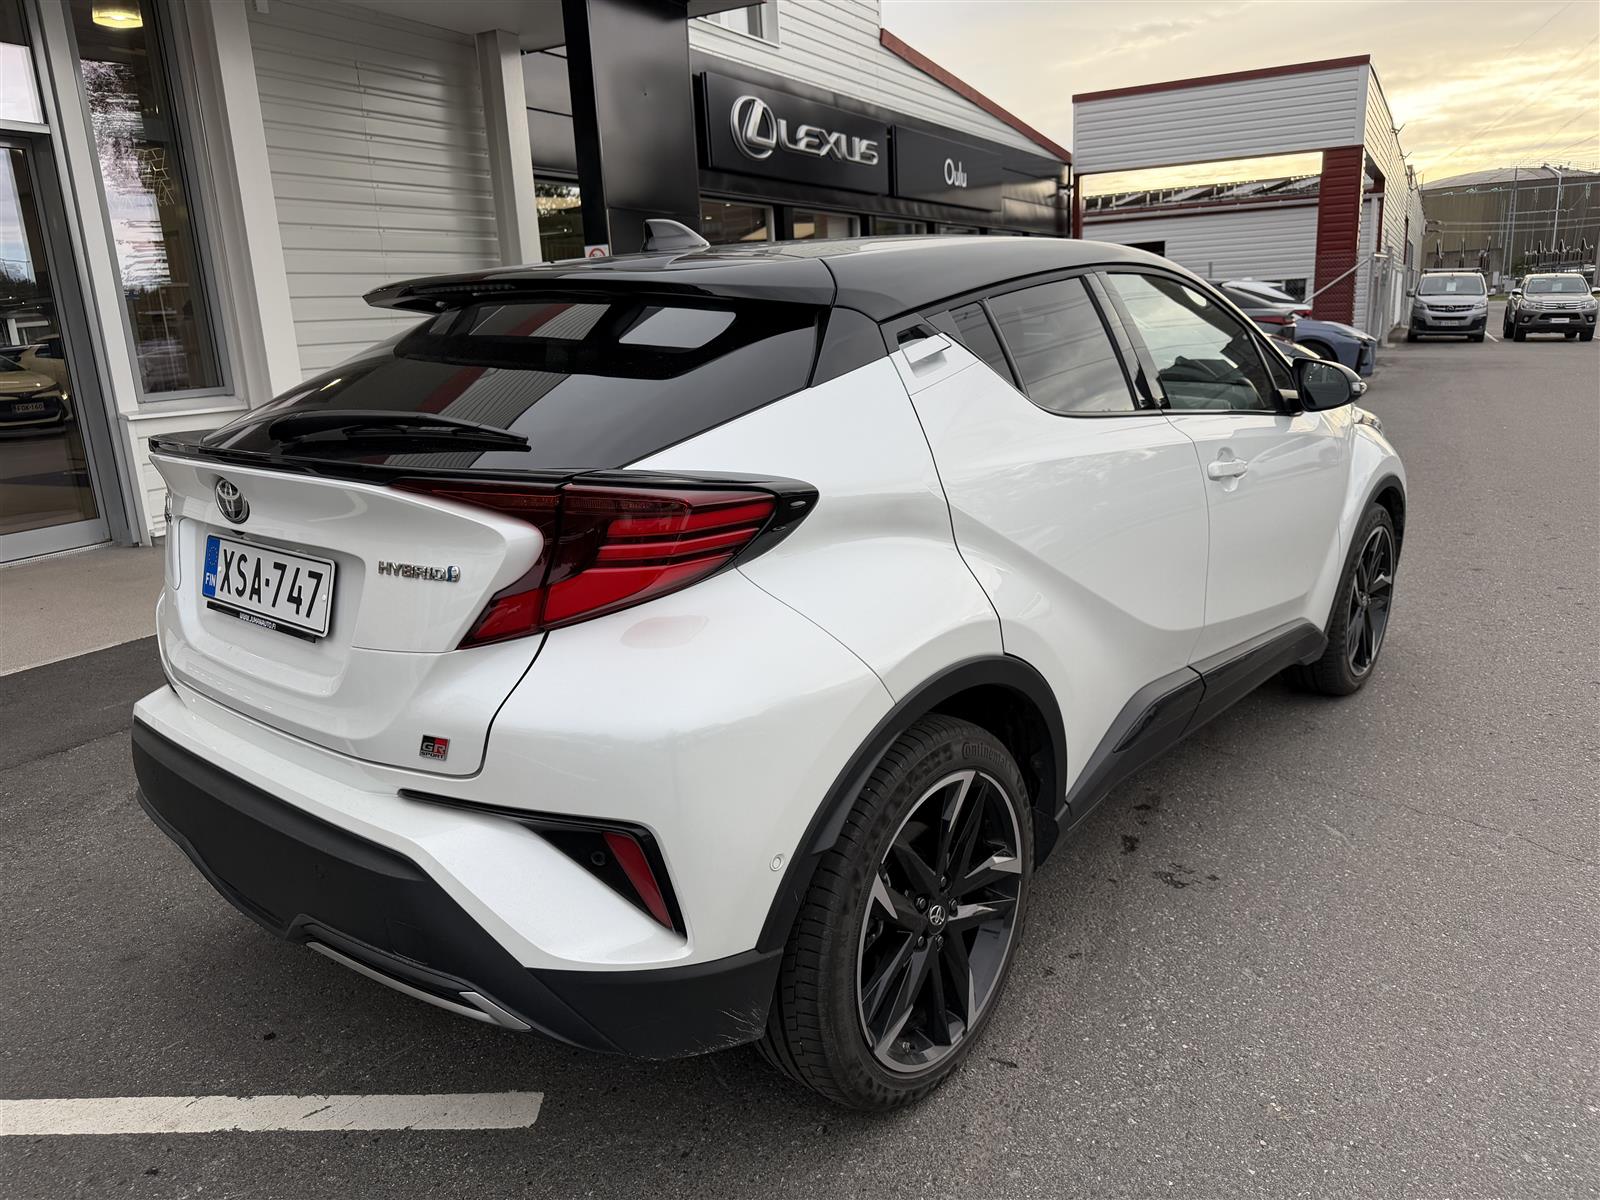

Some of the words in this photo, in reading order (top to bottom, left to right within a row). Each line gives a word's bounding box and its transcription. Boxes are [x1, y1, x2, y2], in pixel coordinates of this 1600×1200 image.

[777, 118, 879, 165] LEXUS
[943, 158, 967, 188] Oulu
[205, 572, 216, 587] FIN
[219, 548, 324, 618] XSA-747
[377, 560, 446, 582] HYBRID
[422, 742, 446, 755] GR
[961, 741, 1009, 769] Continental
